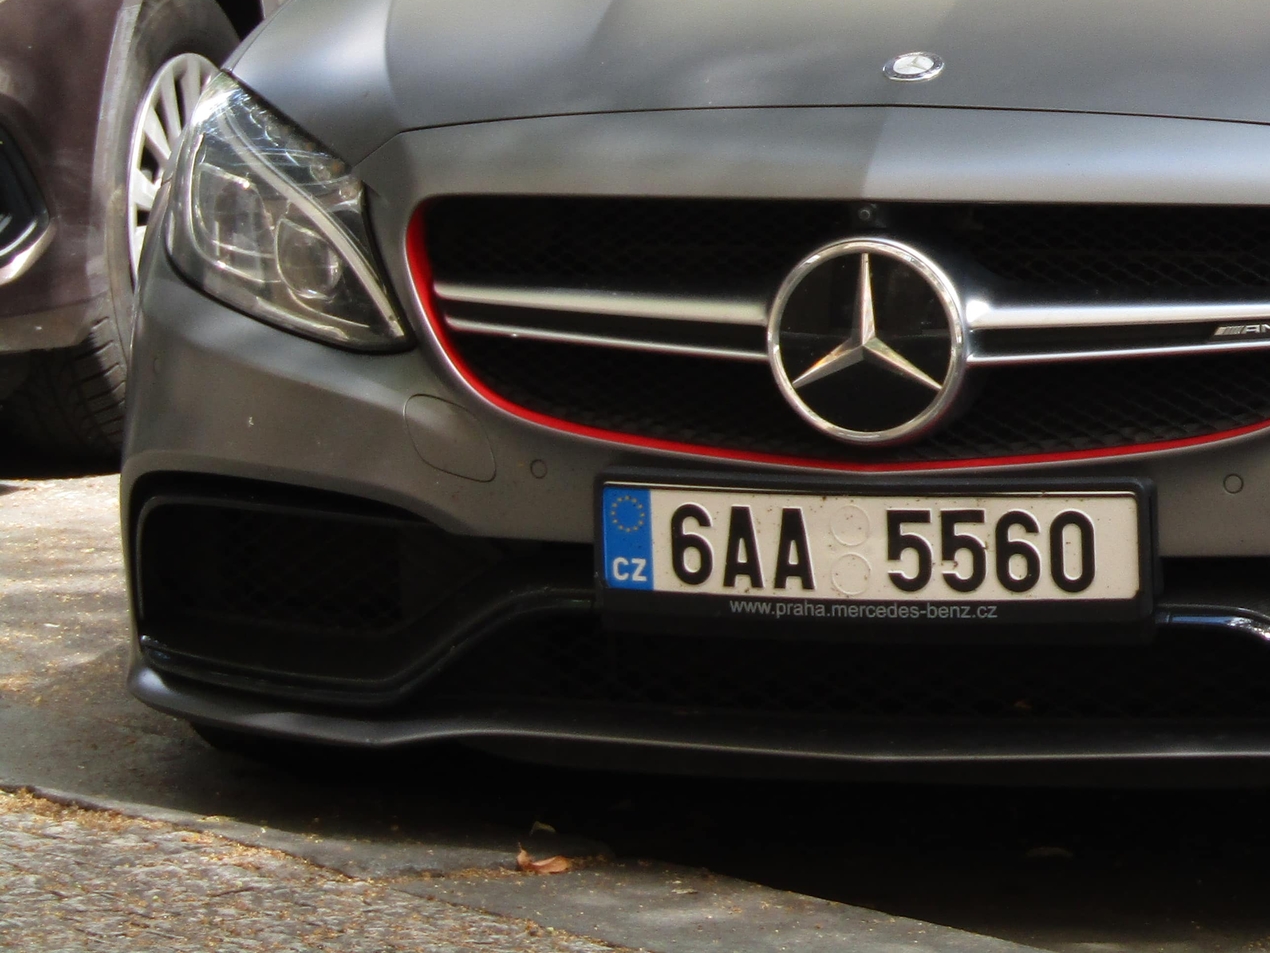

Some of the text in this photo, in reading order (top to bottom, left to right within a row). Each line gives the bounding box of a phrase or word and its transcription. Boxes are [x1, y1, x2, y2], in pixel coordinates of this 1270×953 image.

[670, 503, 1096, 594] 6AA 5560
[612, 556, 648, 582] CZ
[729, 599, 998, 619] www.praha.mercedes-benz.cz
